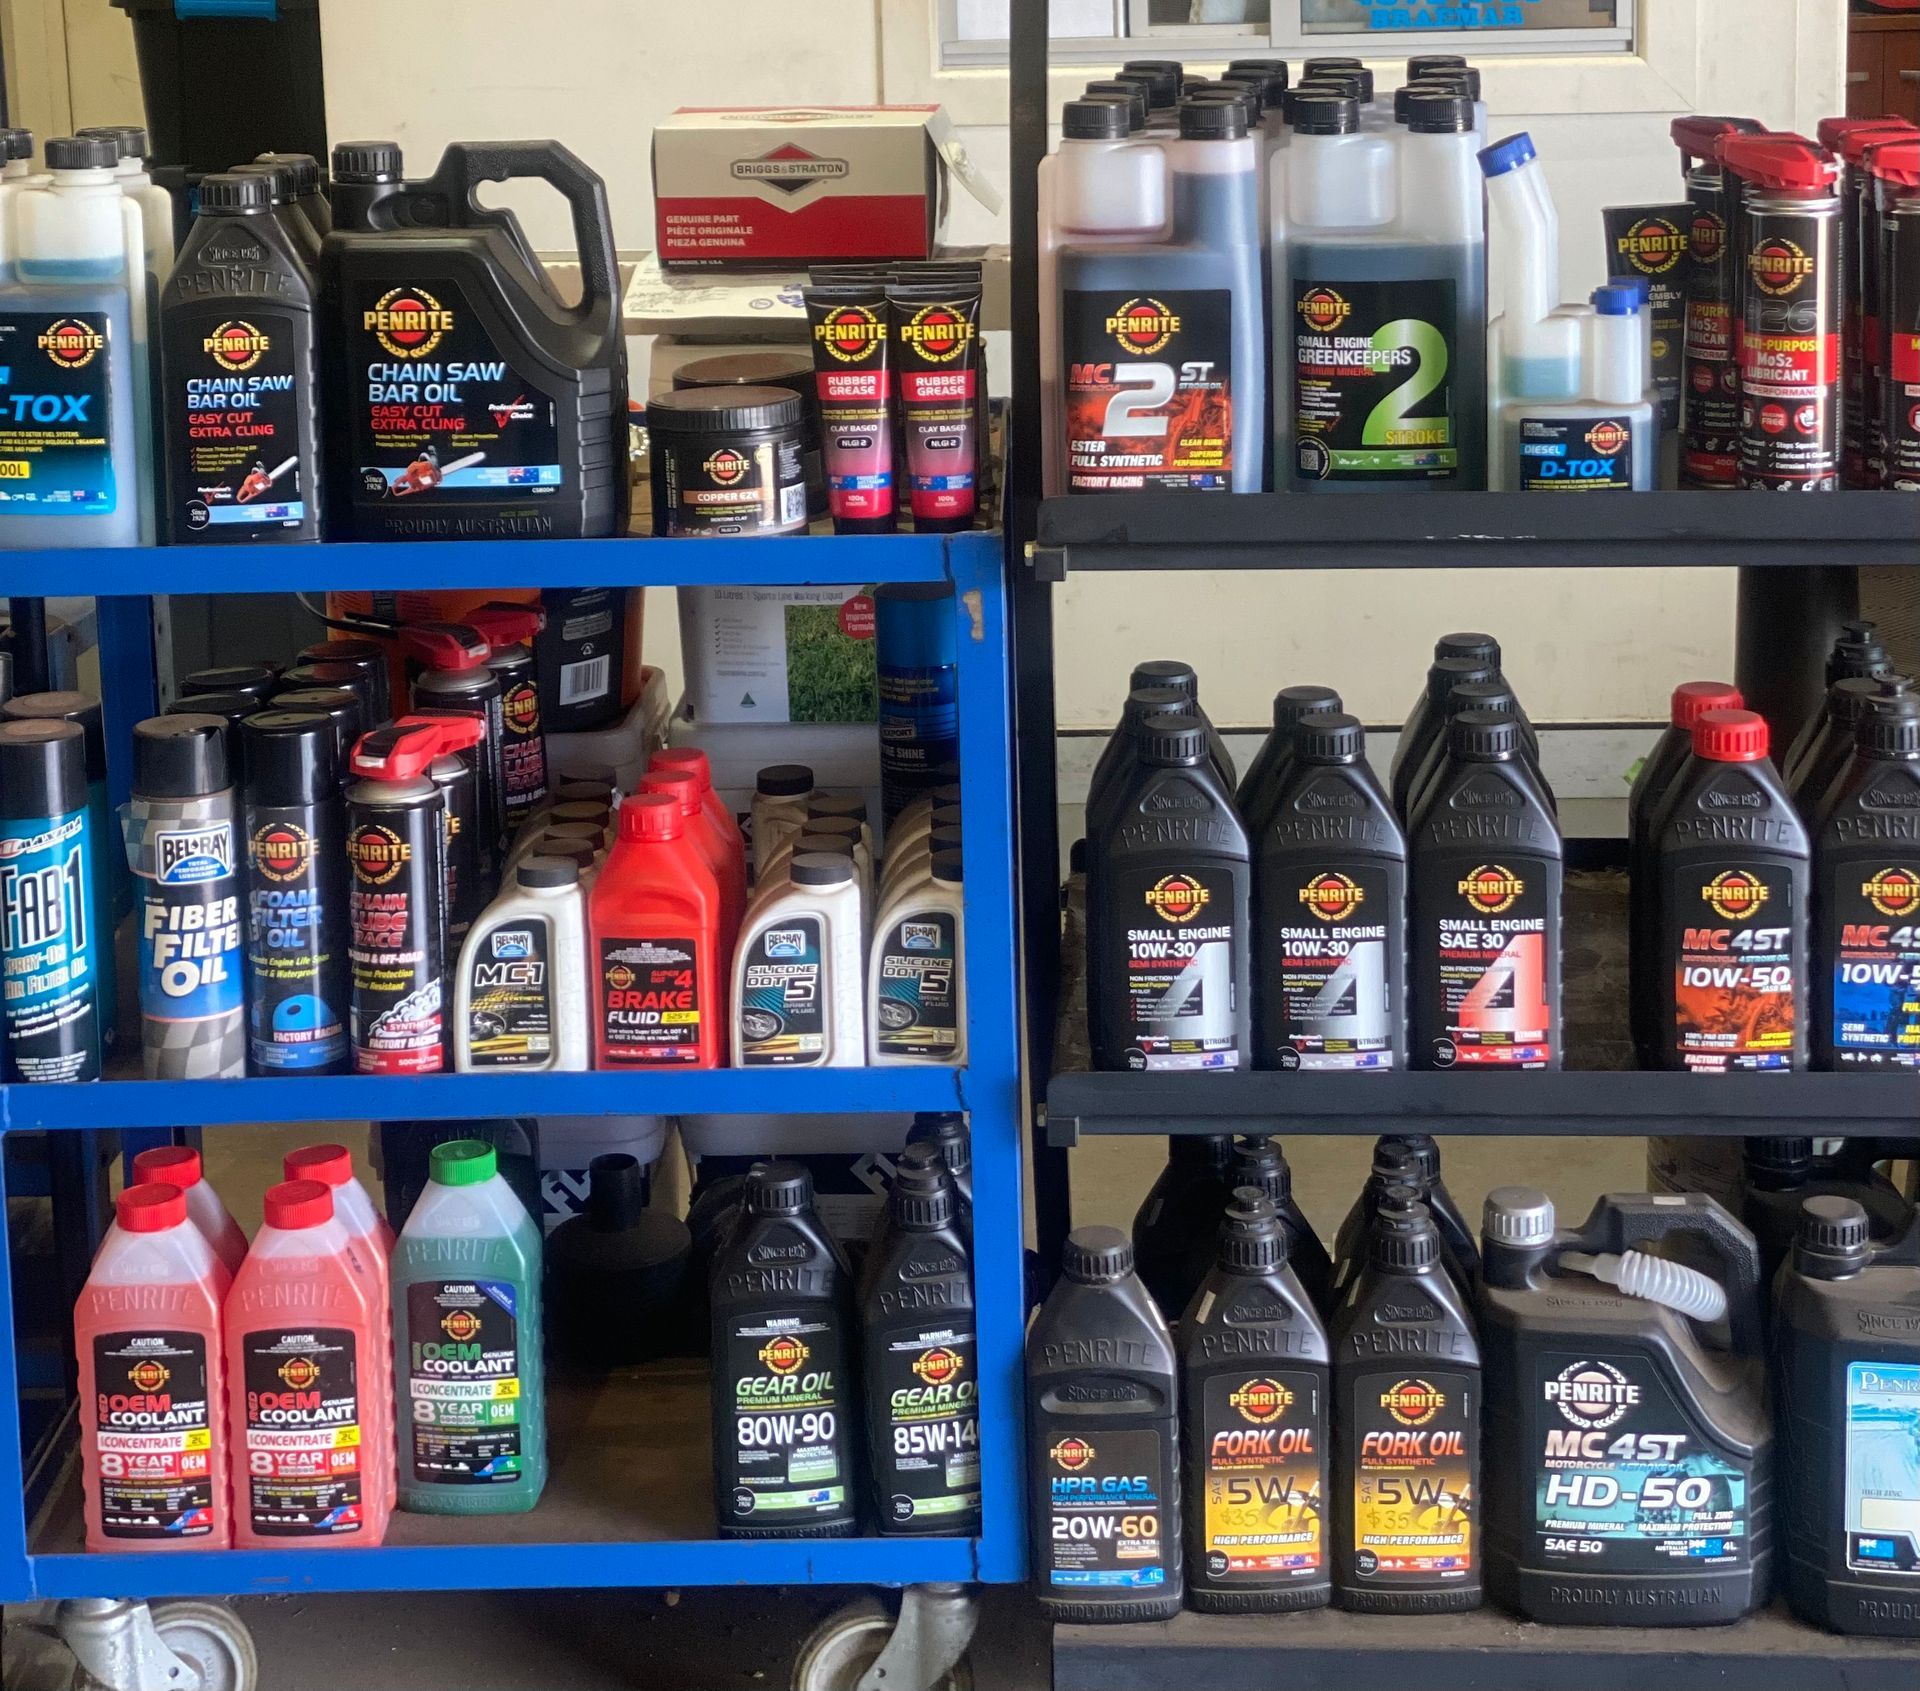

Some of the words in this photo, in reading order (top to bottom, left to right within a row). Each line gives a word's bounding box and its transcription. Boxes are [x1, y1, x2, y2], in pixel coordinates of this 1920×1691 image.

[737, 165, 779, 175] BRIGGS
[789, 164, 842, 174] STRATTON
[666, 215, 711, 223] GENUINE
[713, 215, 739, 223] PART
[698, 226, 752, 235] ORIGINALE
[667, 238, 697, 247] PIEZA
[699, 238, 745, 247] GENUINA
[1297, 301, 1350, 316] PENRITE
[364, 311, 453, 330] PENRITE
[1106, 317, 1180, 334] PENRITE
[815, 323, 887, 341] PENRITE
[901, 323, 975, 341] PENRITE
[38, 335, 104, 349] PENRITE
[203, 336, 271, 352] PENRITE
[1298, 336, 1333, 348] SMALL
[1334, 337, 1374, 349] ENGINE
[368, 363, 441, 381] CHAIN
[446, 362, 505, 381] SAW
[187, 377, 241, 394] CHAIN
[247, 375, 293, 391] SAW
[828, 376, 876, 385] RUBBER
[916, 376, 966, 387] RUBBER
[1298, 349, 1411, 365] GREENKEEPERS
[1362, 318, 1448, 445] 2
[369, 383, 418, 402] BAR
[424, 383, 463, 402] OIL
[829, 386, 876, 396] GREASE
[917, 386, 966, 396] GREASE
[188, 394, 227, 409] BAR
[230, 393, 261, 408] OIL
[1071, 363, 1111, 383] MC
[1102, 362, 1175, 437] 2
[1180, 362, 1215, 382] ST
[189, 414, 224, 424] EASY
[226, 412, 254, 423] CUT
[371, 405, 408, 418] EASY
[413, 405, 443, 417] CUT
[189, 426, 231, 438] EXTRA
[235, 424, 275, 437] CLING
[371, 419, 417, 430] EXTRA
[422, 418, 465, 430] CLING
[1071, 441, 1106, 452] ESTER
[1524, 445, 1561, 454] DIESEL
[1071, 456, 1097, 466] FULL
[1100, 455, 1164, 467] SYNTHETIC
[1540, 459, 1616, 477] D-TOX
[1072, 476, 1109, 486] FACTORY
[1110, 476, 1144, 487] RACING
[697, 493, 735, 501] COPPER
[1458, 880, 1523, 895] PENRITE
[1702, 886, 1769, 901] PENRITE
[351, 892, 408, 911] CHAIN
[1145, 889, 1209, 905] PENRITE
[1299, 888, 1364, 903] PENRITE
[144, 896, 237, 938] FIBER
[351, 911, 408, 931] LUBE
[1439, 919, 1487, 931] SMALL
[1490, 918, 1544, 931] ENGINE
[267, 929, 305, 948] OIL
[1127, 929, 1175, 941] SMALL
[1178, 926, 1231, 940] ENGINE
[1281, 928, 1329, 940] SMALL
[1332, 925, 1386, 938] ENGINE
[1682, 928, 1730, 951] MC
[1730, 928, 1791, 951] 4ST
[1841, 924, 1890, 947] MC
[1439, 932, 1477, 949] SAE
[1482, 932, 1504, 948] 30
[1129, 942, 1196, 959] 10W-30
[1282, 941, 1350, 957] 10W-30
[1439, 950, 1481, 959] PREMIUM
[884, 956, 953, 968] SILICONE
[161, 957, 228, 998] OIL
[747, 963, 818, 977] SILICONE
[1682, 966, 1791, 988] 10W-50
[784, 976, 816, 1002] 5
[919, 969, 953, 995] 5
[608, 991, 693, 1009] BRAKE
[608, 1011, 660, 1023] FLUID
[1842, 1023, 1864, 1032] SEMI
[273, 1031, 313, 1043] FACTORY
[1842, 1033, 1889, 1043] SYNTHETIC
[1684, 1055, 1727, 1064] FACTORY
[444, 1285, 475, 1293] CAUTION
[441, 1319, 482, 1329] PENRITE
[766, 1318, 800, 1328] WARNING
[131, 1338, 164, 1346] CAUTION
[281, 1335, 314, 1344] CAUTION
[919, 1329, 953, 1341] WARNING
[422, 1343, 482, 1361] OEM
[758, 1347, 810, 1361] PENRITE
[423, 1359, 515, 1374] COOLANT
[913, 1356, 964, 1373] PENRITE
[128, 1369, 171, 1381] PENRITE
[278, 1367, 321, 1378] PENRITE
[736, 1375, 798, 1397] GEAR
[802, 1372, 834, 1392] OIL
[1545, 1380, 1640, 1404] PENRITE
[109, 1394, 171, 1412] OEM
[259, 1391, 321, 1409] OEM
[737, 1396, 781, 1405] PREMIUM
[782, 1393, 823, 1403] MINERAL
[891, 1384, 953, 1407] GEAR
[1230, 1392, 1293, 1408] PENRITE
[1381, 1394, 1445, 1409] PENRITE
[109, 1409, 205, 1425] COOLANT
[259, 1405, 356, 1423] COOLANT
[413, 1400, 435, 1422] 8
[437, 1402, 484, 1415] YEAR
[490, 1403, 515, 1418] OEM
[738, 1412, 835, 1446] 80W-90
[1211, 1430, 1276, 1457] FORK
[1279, 1428, 1312, 1454] OIL
[1361, 1431, 1427, 1456] FORK
[1429, 1431, 1463, 1456] OIL
[1545, 1429, 1607, 1458] MC
[1607, 1432, 1687, 1461] 4ST
[1050, 1448, 1095, 1459] PENRITE
[1212, 1457, 1235, 1466] FULL
[1236, 1456, 1284, 1465] SYNTHETIC
[101, 1455, 124, 1476] 8
[125, 1455, 174, 1467] YEAR
[181, 1455, 207, 1470] OEM
[251, 1452, 274, 1474] 8
[275, 1453, 324, 1464] YEAR
[331, 1452, 356, 1467] OEM
[1361, 1458, 1385, 1466] FULL
[1385, 1457, 1436, 1466] SYNTHETIC
[1545, 1459, 1616, 1470] MOTORCYCLE
[1052, 1477, 1097, 1493] HPR
[1102, 1476, 1148, 1492] GAS
[1227, 1475, 1296, 1505] 5W
[1377, 1476, 1447, 1505] 5W
[1545, 1474, 1711, 1508] HD-50
[1366, 1508, 1411, 1530] $35
[1692, 1510, 1713, 1520] FULL
[1714, 1510, 1734, 1520] ZINC
[1052, 1515, 1158, 1539] 20W-60
[1545, 1520, 1586, 1530] PREMIUM
[1588, 1521, 1624, 1531] MINERAL
[1638, 1523, 1682, 1532] MAXIMUM
[1682, 1521, 1733, 1531] PROTECTION
[1212, 1534, 1239, 1546] HIGH
[1240, 1532, 1314, 1545] PERFORMANCE
[1362, 1535, 1389, 1545] HIGH
[1390, 1533, 1464, 1545] PERFORMANCE
[1545, 1538, 1577, 1551] SAE
[1579, 1539, 1603, 1553] 50
